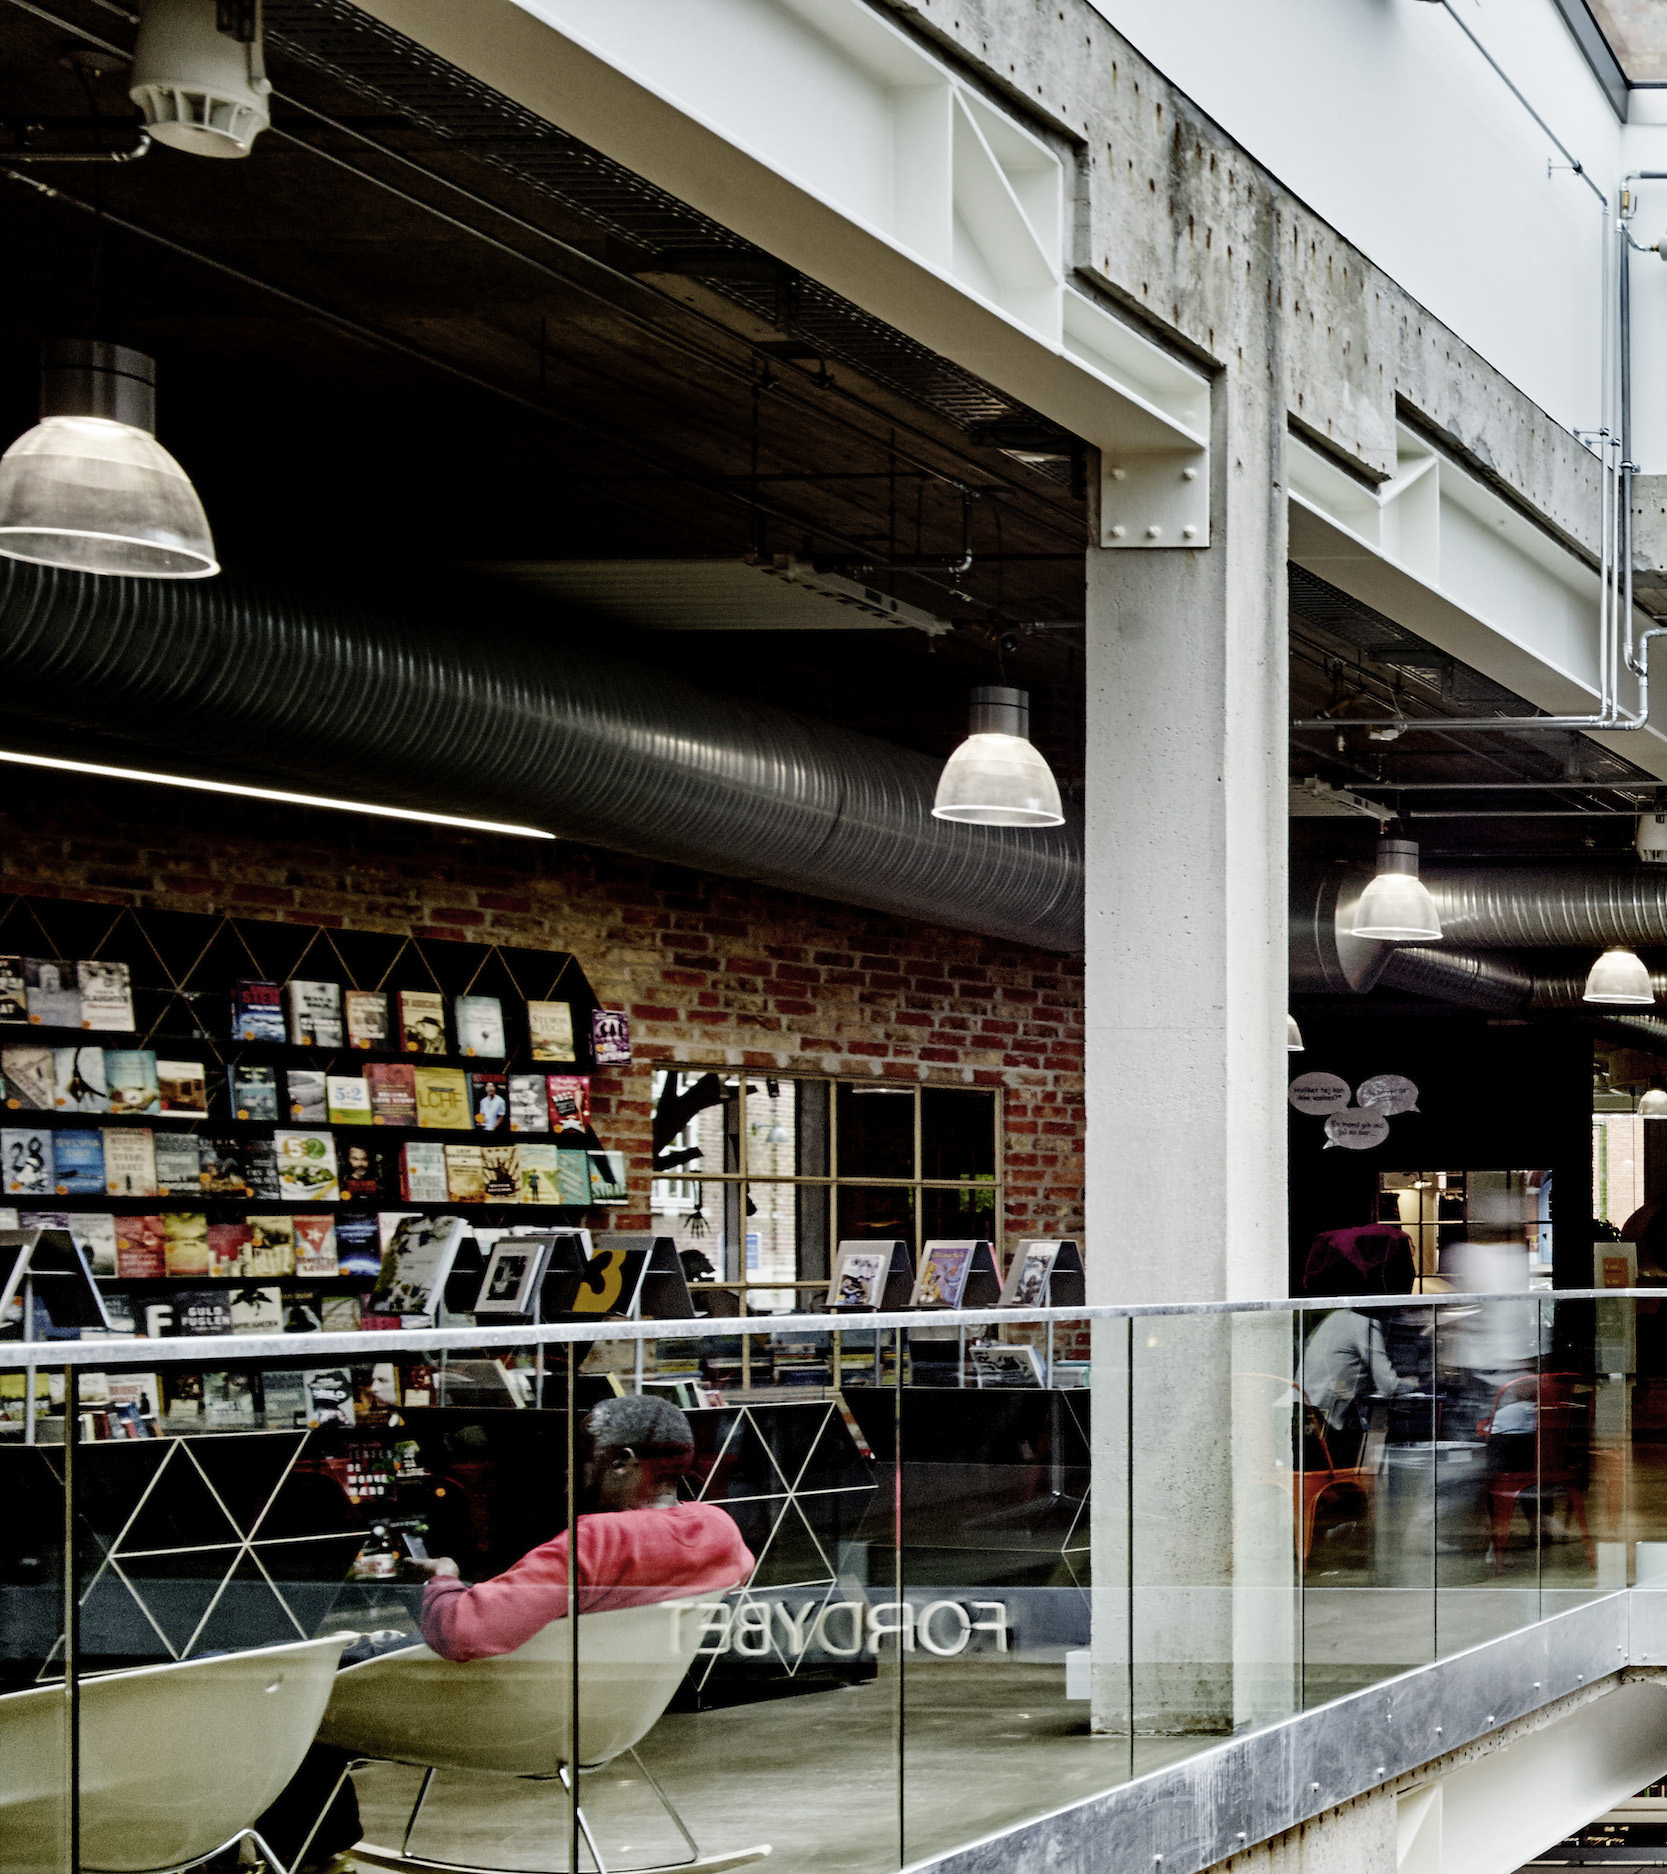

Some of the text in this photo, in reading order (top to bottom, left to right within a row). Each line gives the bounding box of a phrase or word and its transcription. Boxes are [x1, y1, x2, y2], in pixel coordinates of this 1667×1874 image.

[334, 1087, 363, 1102] 5:2
[418, 1089, 463, 1109] LCHF
[188, 1306, 223, 1317] GULD
[181, 1316, 231, 1326] FUGLEN
